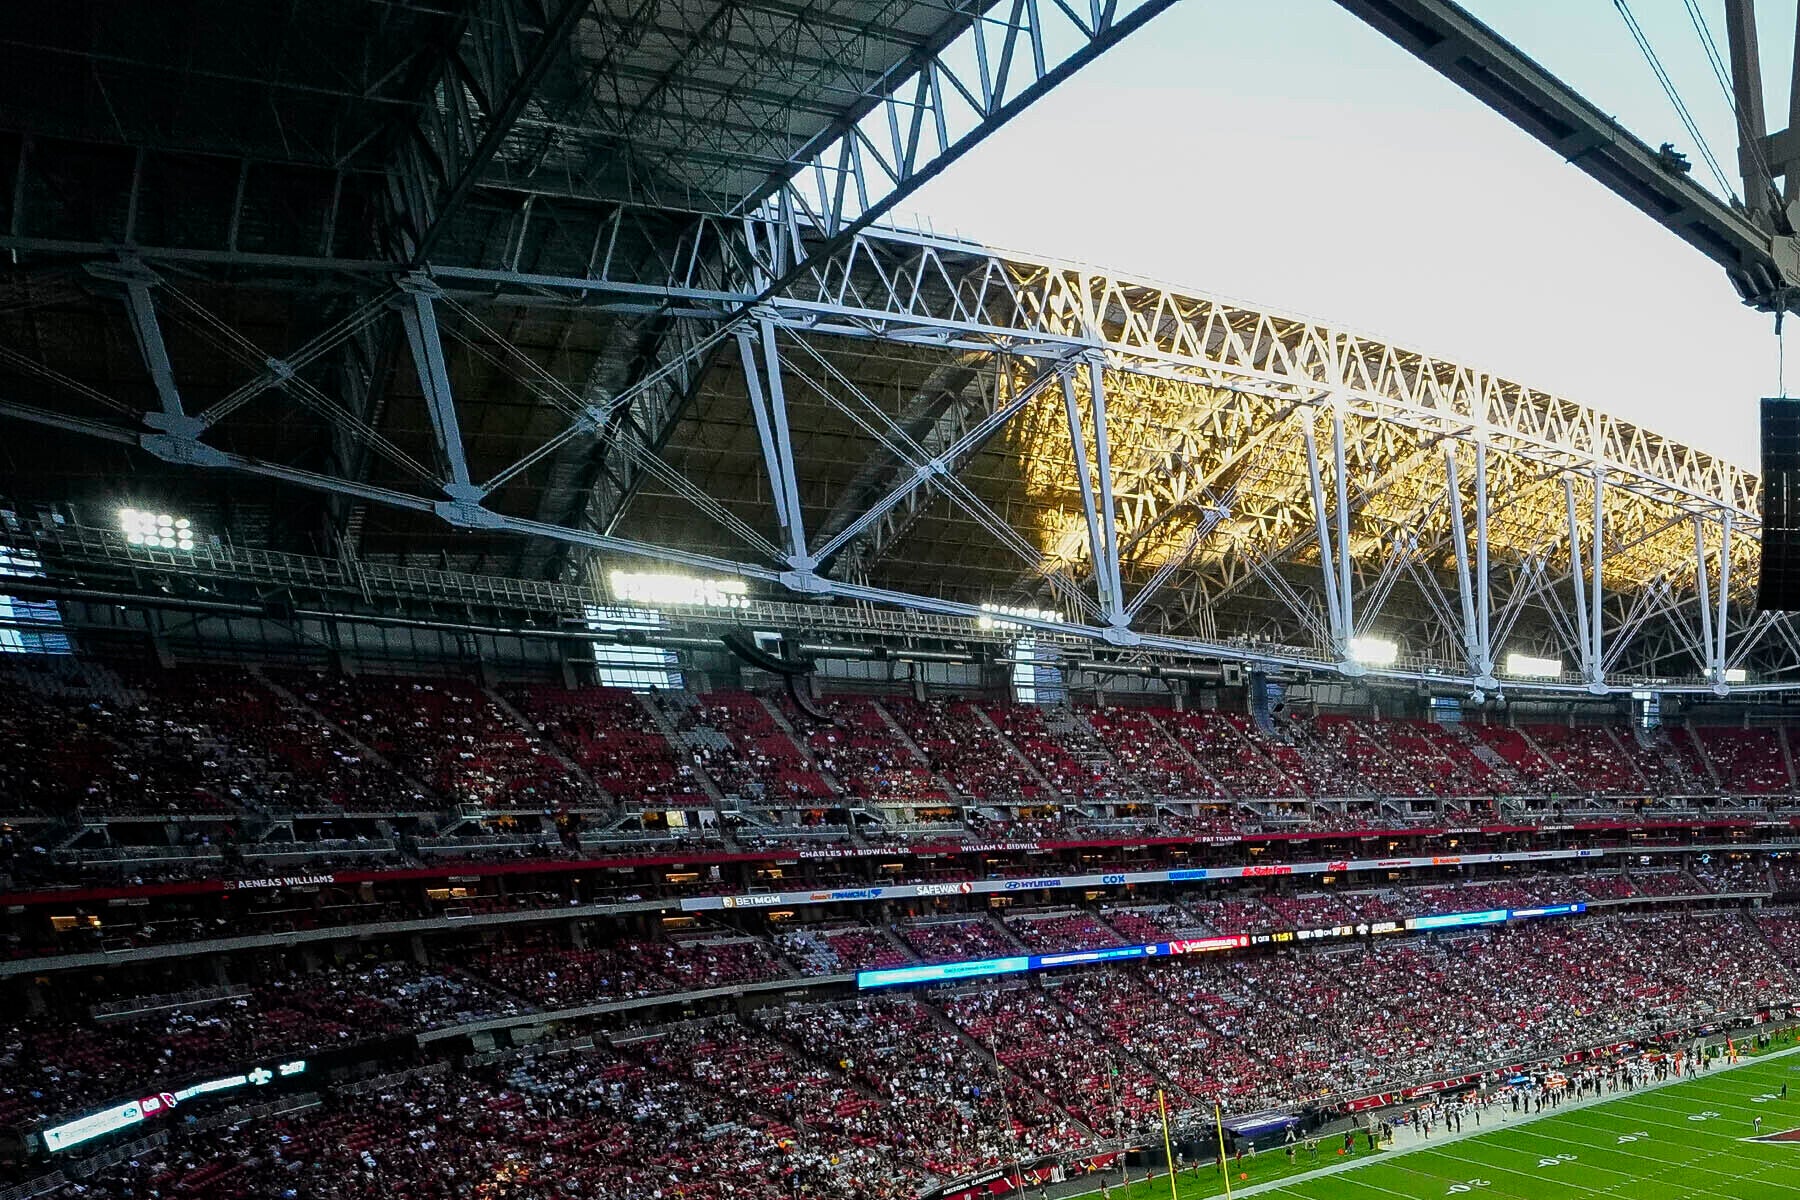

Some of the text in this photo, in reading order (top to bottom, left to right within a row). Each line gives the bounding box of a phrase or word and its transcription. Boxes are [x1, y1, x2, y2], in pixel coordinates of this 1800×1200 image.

[960, 844, 997, 852] WILLIAM
[1006, 842, 1040, 850] BIDWILL
[799, 849, 842, 858] CHARLES
[843, 849, 856, 857] W.
[238, 878, 282, 890] AENEAS
[283, 874, 335, 887] WILLIAMS
[1021, 879, 1061, 888] HYUNDAI
[1102, 875, 1125, 884] COX
[916, 884, 959, 896] SAFEWAY
[735, 895, 781, 906] BETMGM
[1539, 1153, 1578, 1165] 30
[971, 1171, 1004, 1187] CARDINALS
[1449, 1178, 1491, 1192] 20
